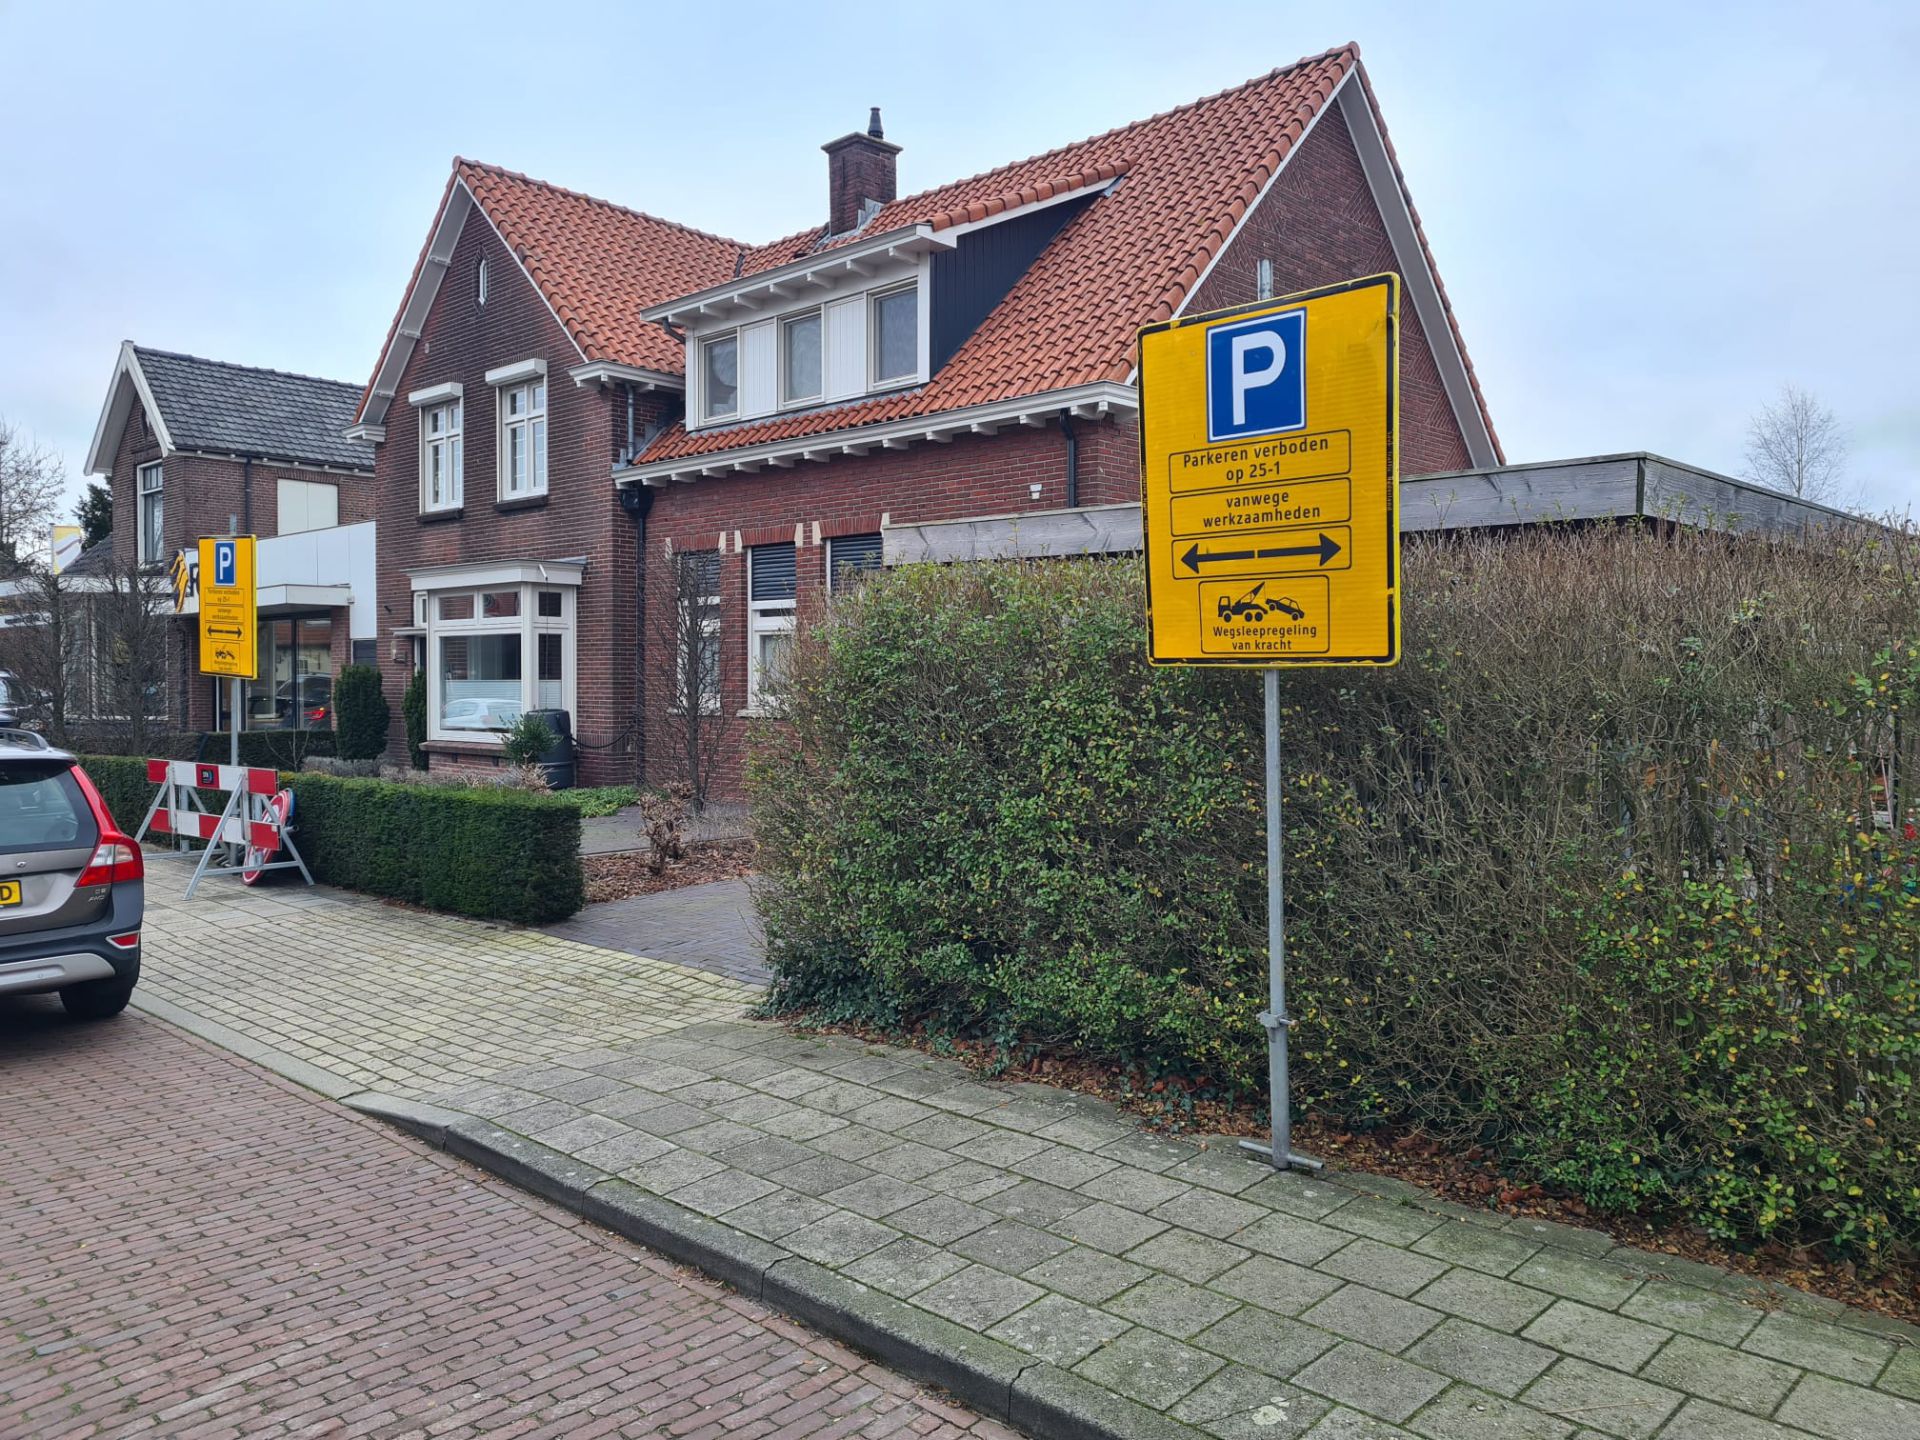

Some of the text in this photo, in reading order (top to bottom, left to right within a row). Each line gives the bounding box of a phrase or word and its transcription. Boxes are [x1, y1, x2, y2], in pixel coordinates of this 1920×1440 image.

[1231, 329, 1287, 426] P
[1183, 437, 1329, 468] Parkeren verboden
[1226, 461, 1281, 484] op 25-1
[1226, 491, 1290, 508] vanwege
[1203, 506, 1321, 529] werkzaamheden
[219, 546, 232, 580] P
[1213, 624, 1317, 639] Wegsleepregeling
[1231, 640, 1292, 651] van kracht
